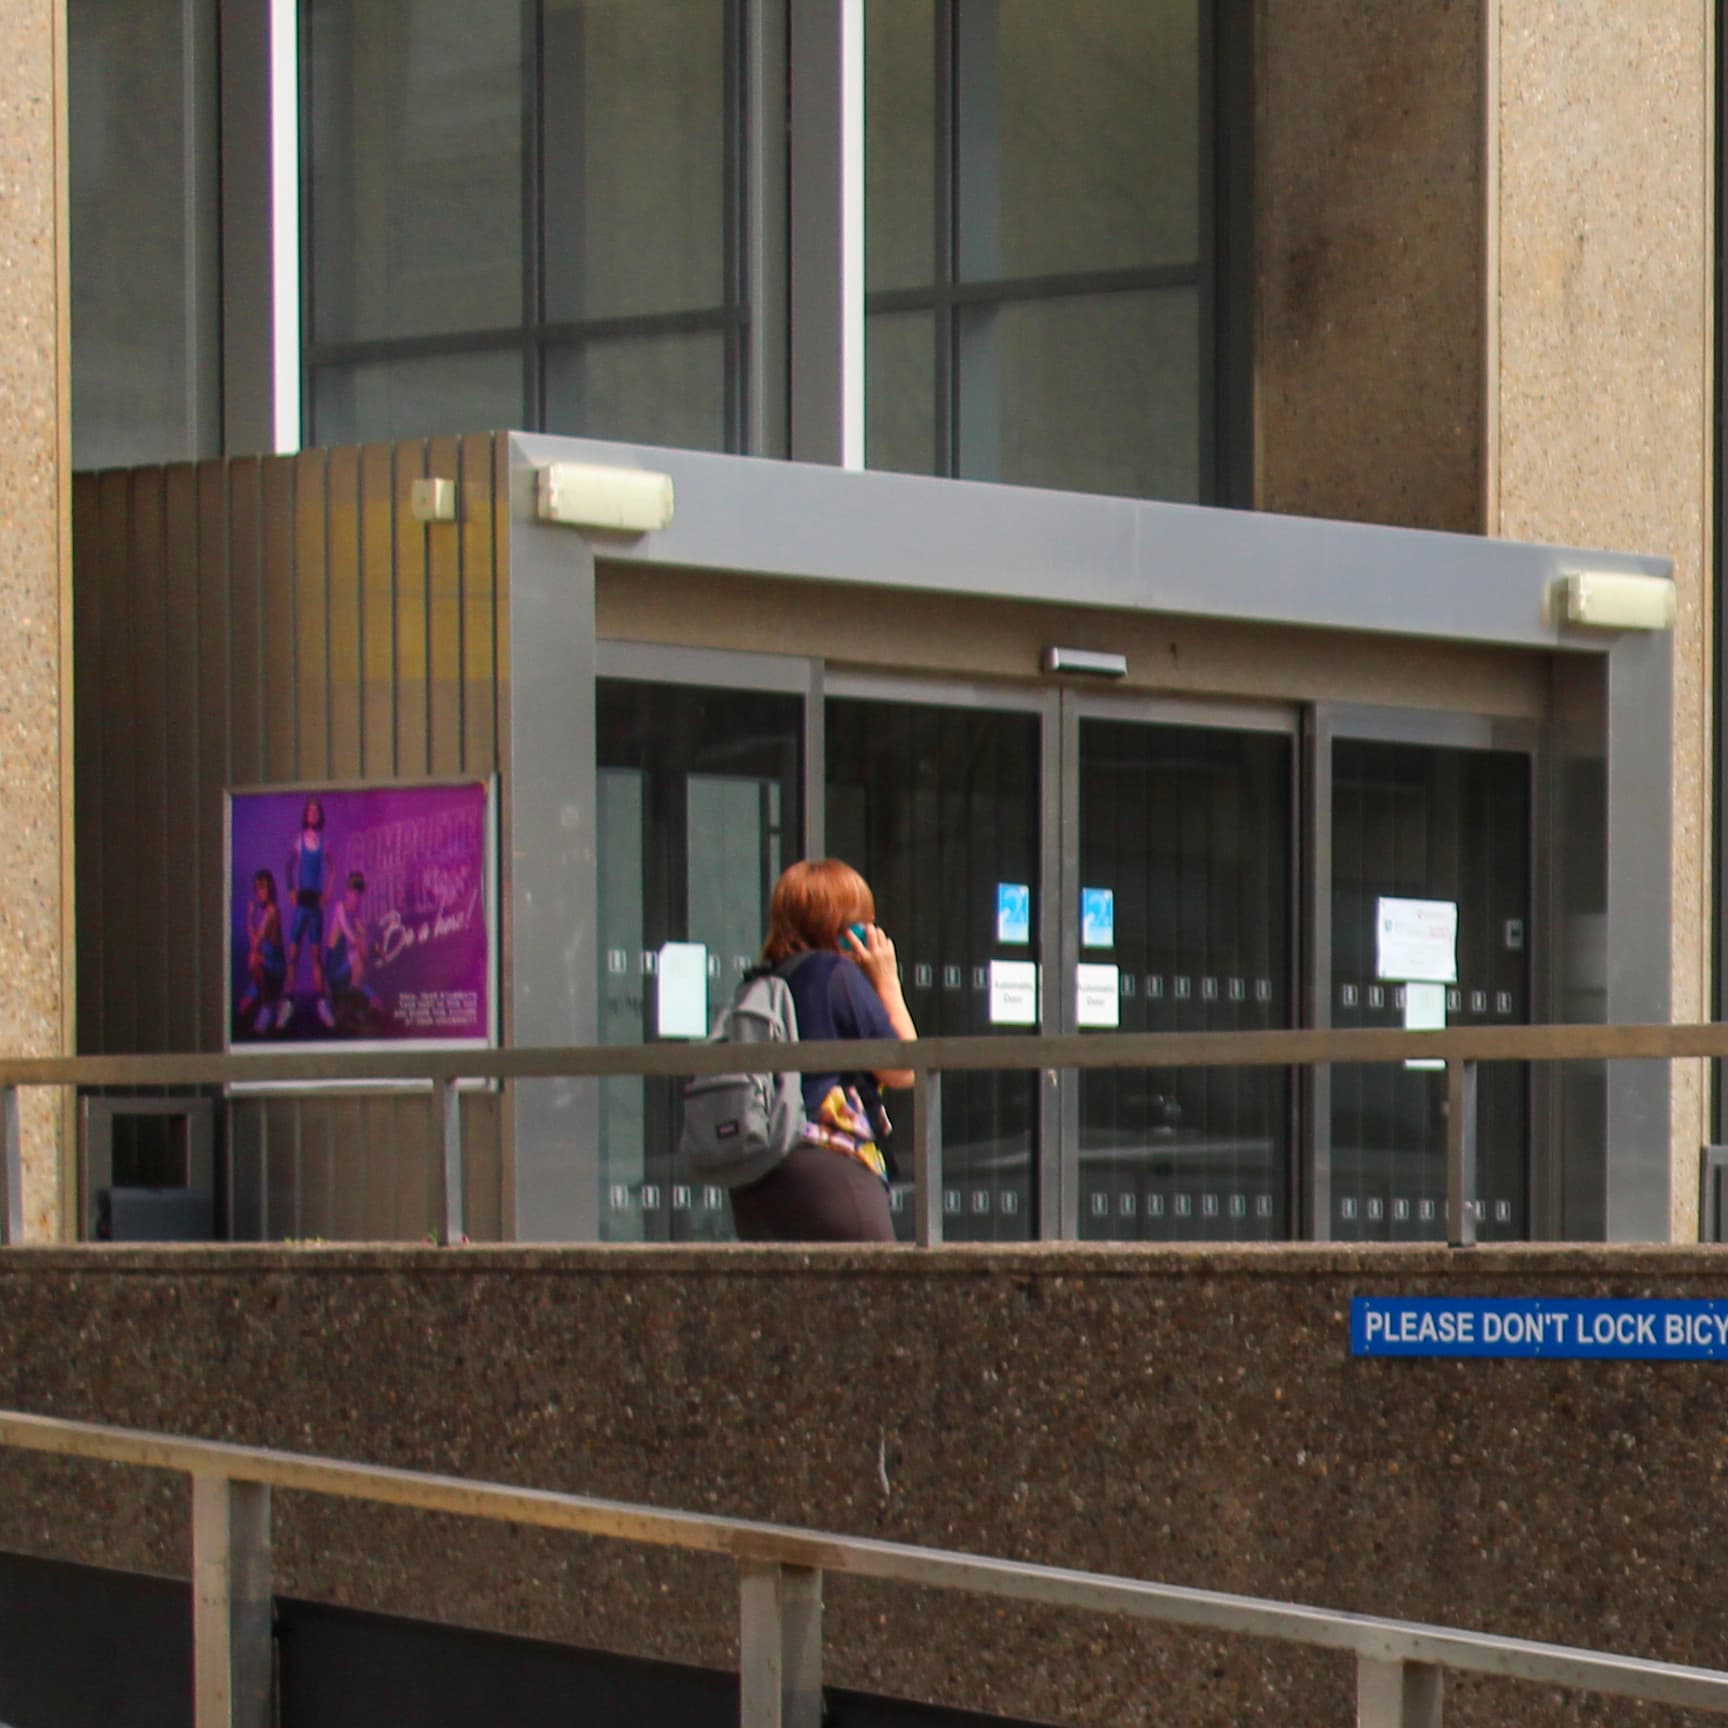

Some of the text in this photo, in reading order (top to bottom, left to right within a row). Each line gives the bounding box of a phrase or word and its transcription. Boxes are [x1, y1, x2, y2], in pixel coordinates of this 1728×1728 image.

[1366, 1312, 1474, 1341] PLEASE
[1484, 1313, 1568, 1342] DON'T
[1577, 1313, 1657, 1343] LOCK
